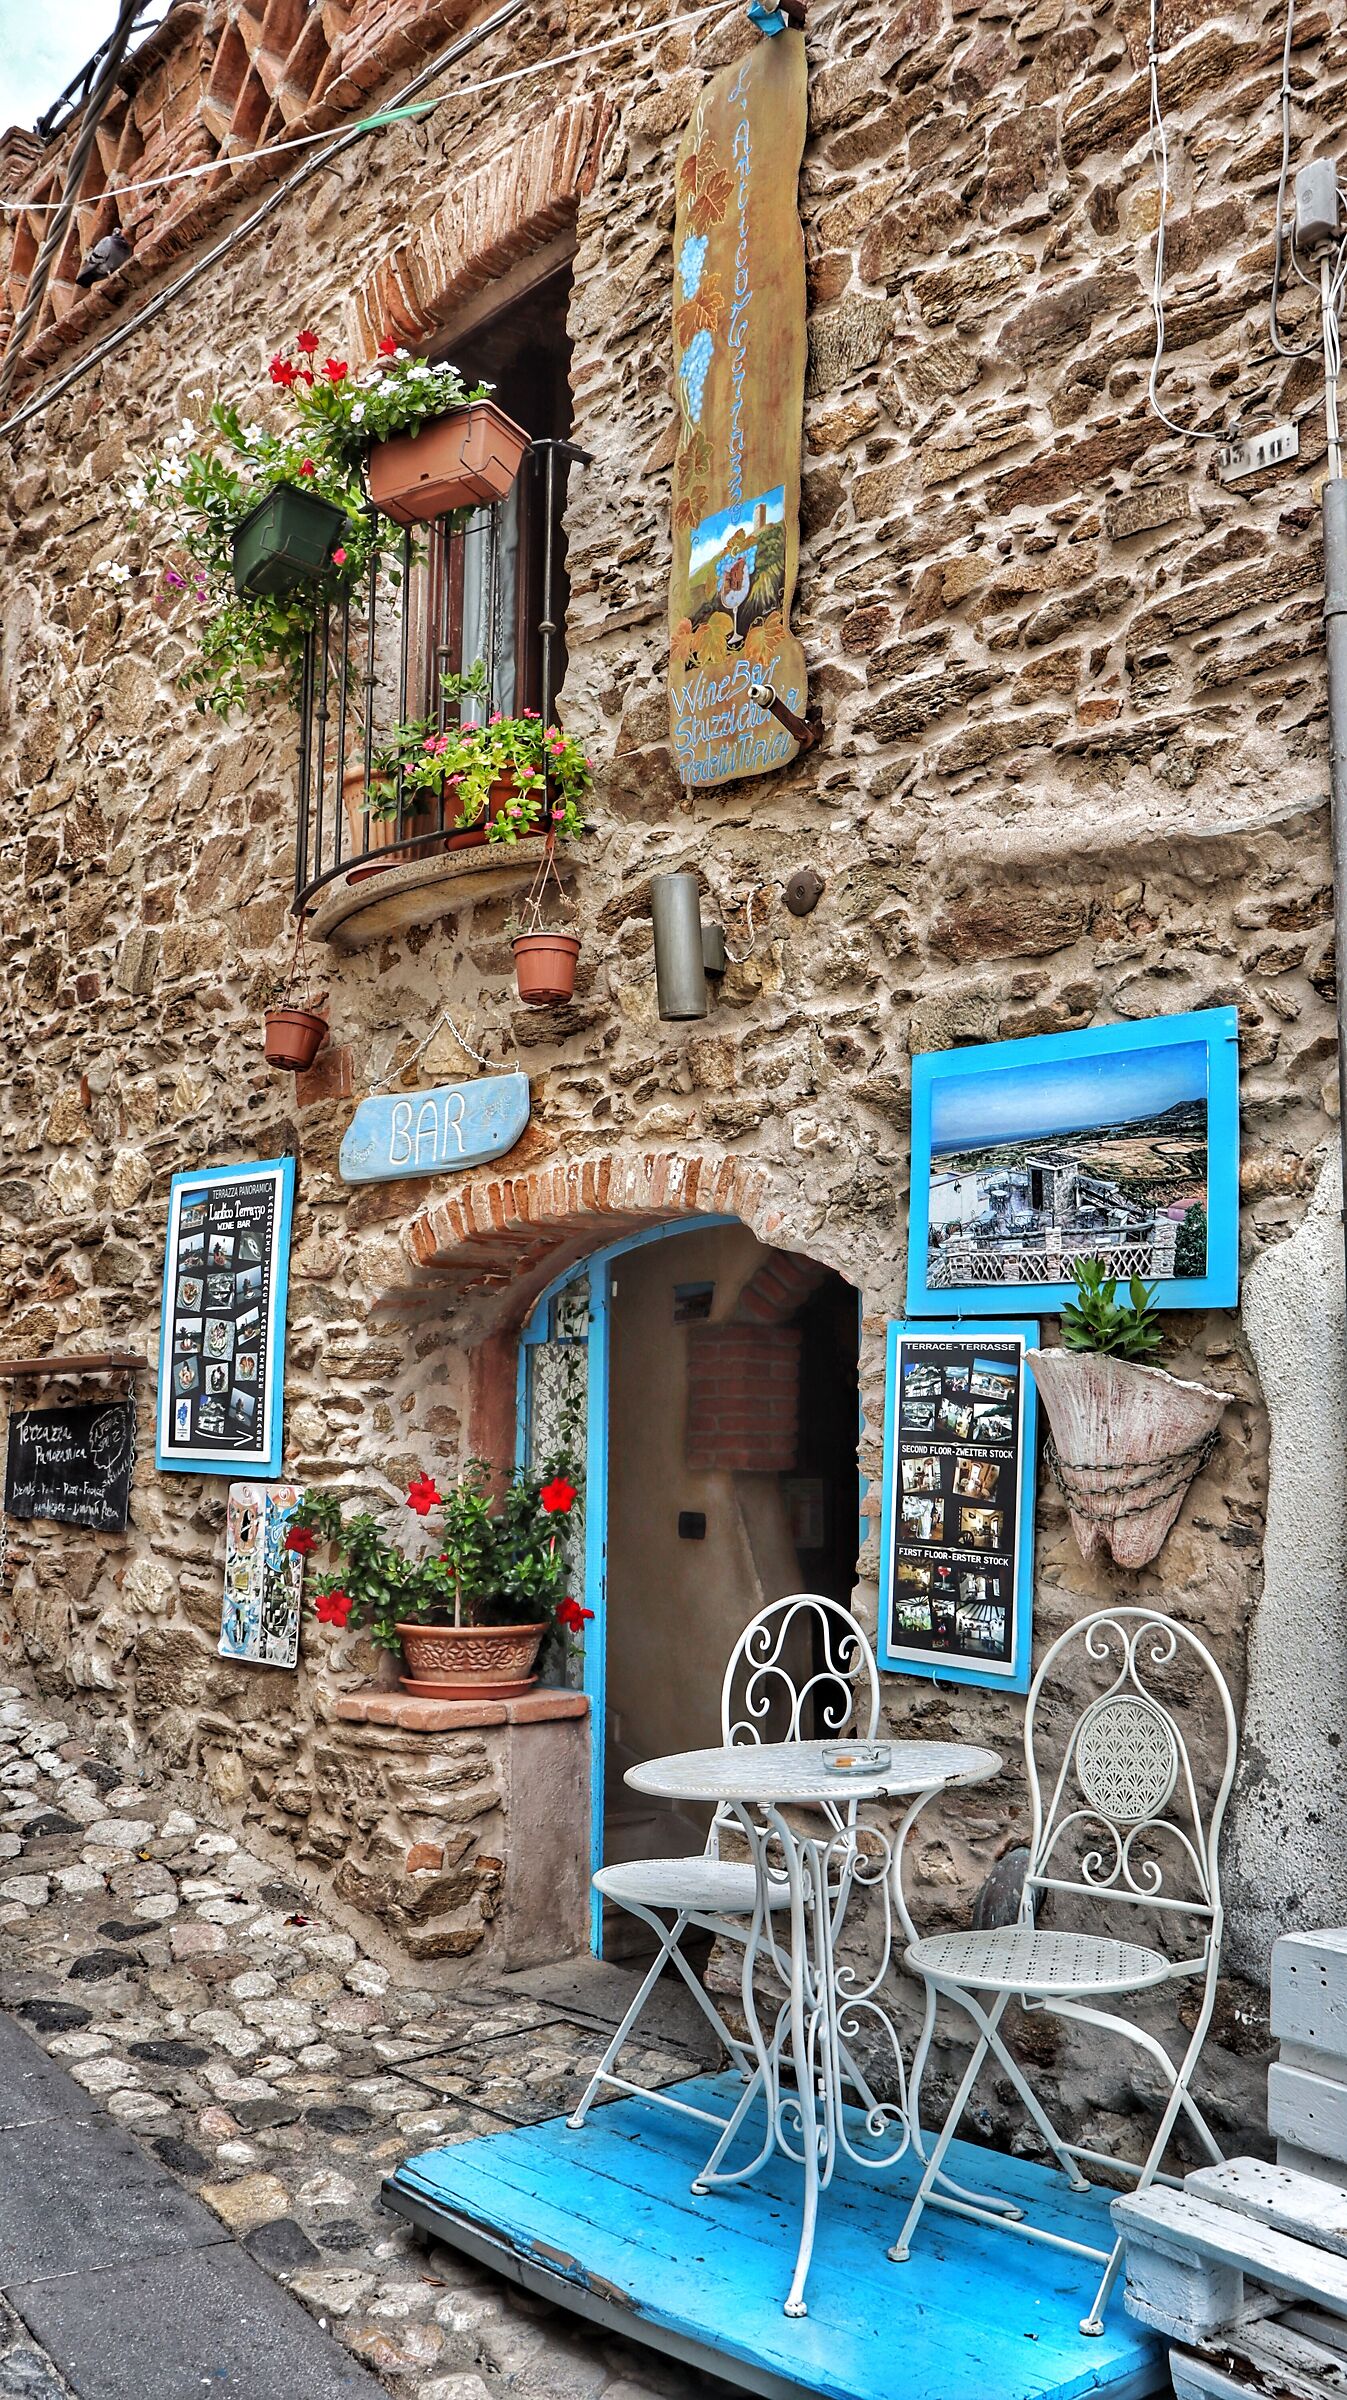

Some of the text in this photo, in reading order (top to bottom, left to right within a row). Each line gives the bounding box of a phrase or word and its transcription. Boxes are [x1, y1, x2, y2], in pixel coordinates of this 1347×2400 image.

[671, 655, 781, 717] Wine Bar
[388, 1092, 466, 1166] BAR
[212, 1182, 273, 1200] TERRAZZA PANORAMICA
[216, 1219, 252, 1231] WINE BAR
[265, 1195, 274, 1252] PANORAMIC
[261, 1259, 271, 1305] TERRACE
[255, 1396, 264, 1449] TERRASSE
[901, 1444, 928, 1454] SECOND
[989, 1449, 1014, 1459] STOCK
[898, 1547, 923, 1558] FIRST
[983, 1555, 1010, 1567] STOCK
